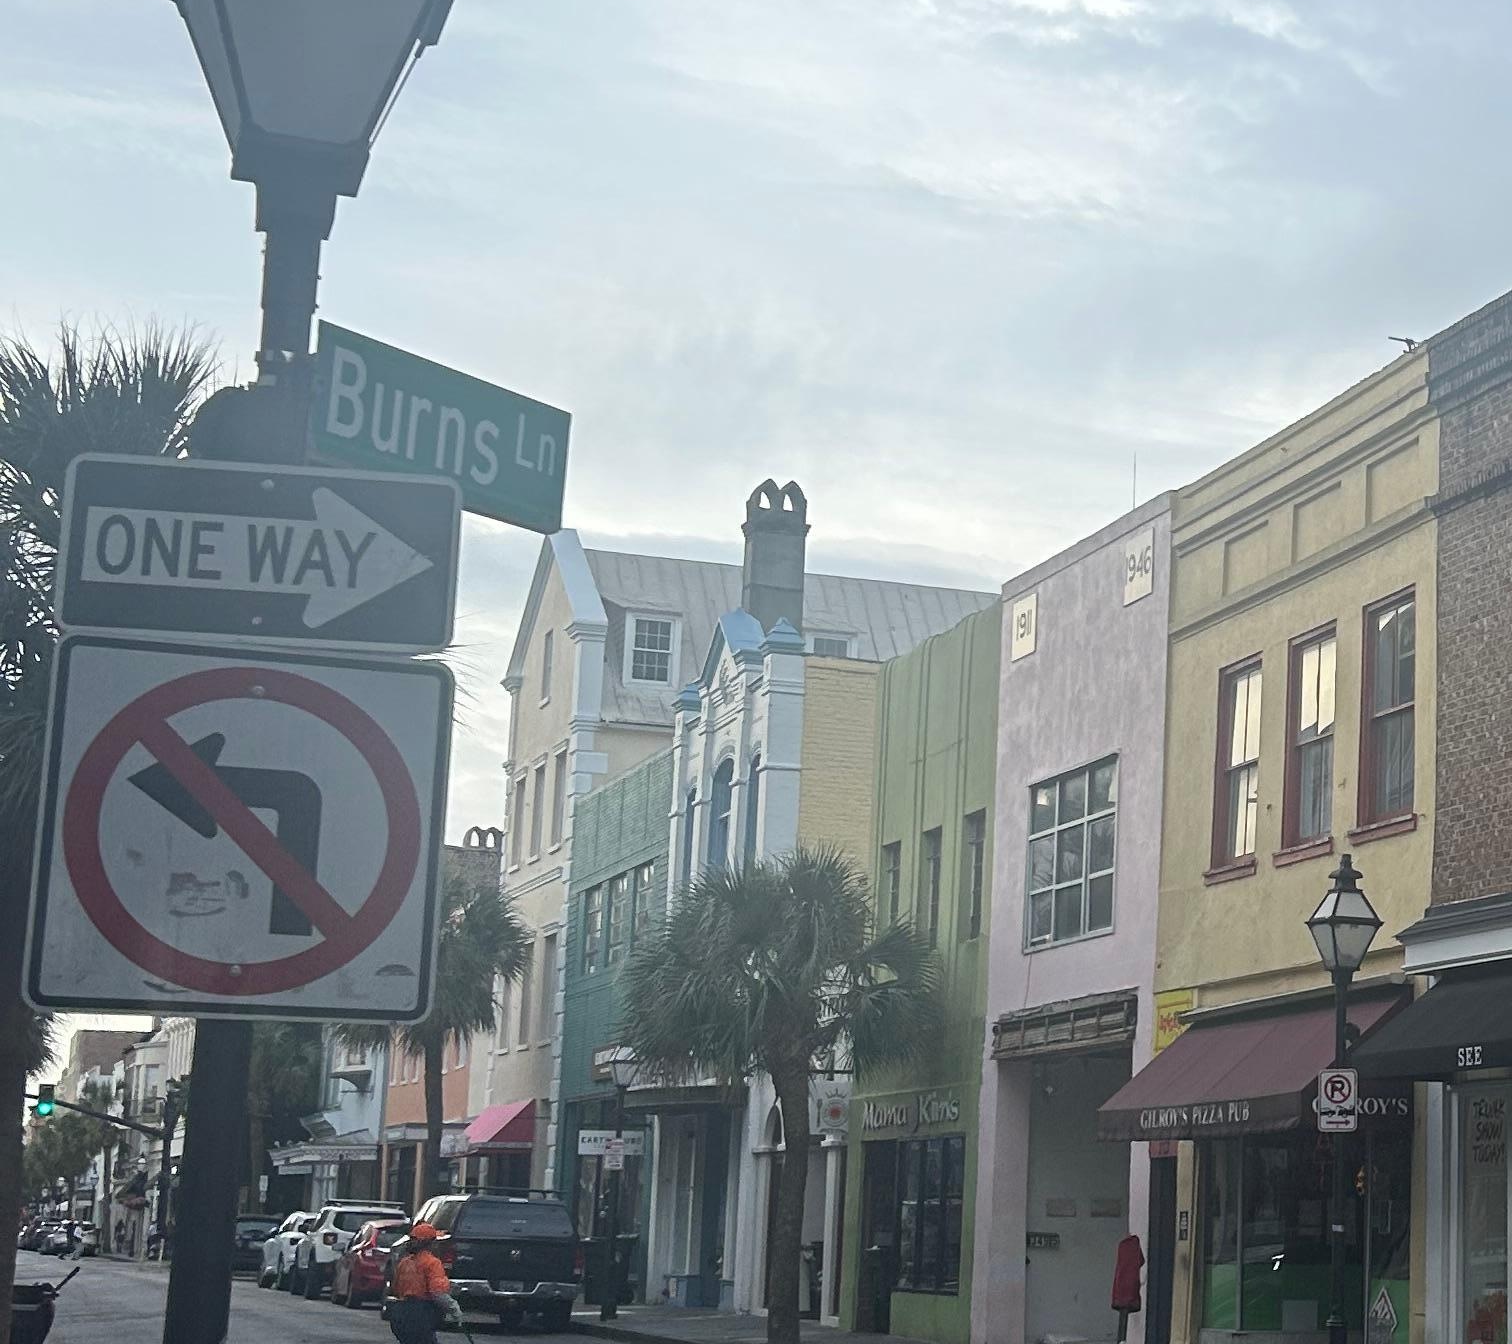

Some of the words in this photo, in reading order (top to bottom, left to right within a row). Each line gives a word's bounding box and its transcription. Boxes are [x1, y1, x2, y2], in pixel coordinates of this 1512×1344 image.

[325, 345, 500, 485] Burns
[515, 412, 556, 477] Ln
[96, 514, 224, 581] ONE
[247, 524, 377, 589] WAY
[1125, 544, 1152, 583] 1946
[1015, 609, 1033, 642] 1911
[1457, 1045, 1483, 1067] SEE
[862, 1101, 907, 1133] Mama
[1140, 1106, 1189, 1129] GILROY'S
[1191, 1103, 1224, 1125] PIZZA
[1227, 1100, 1251, 1123] PUB
